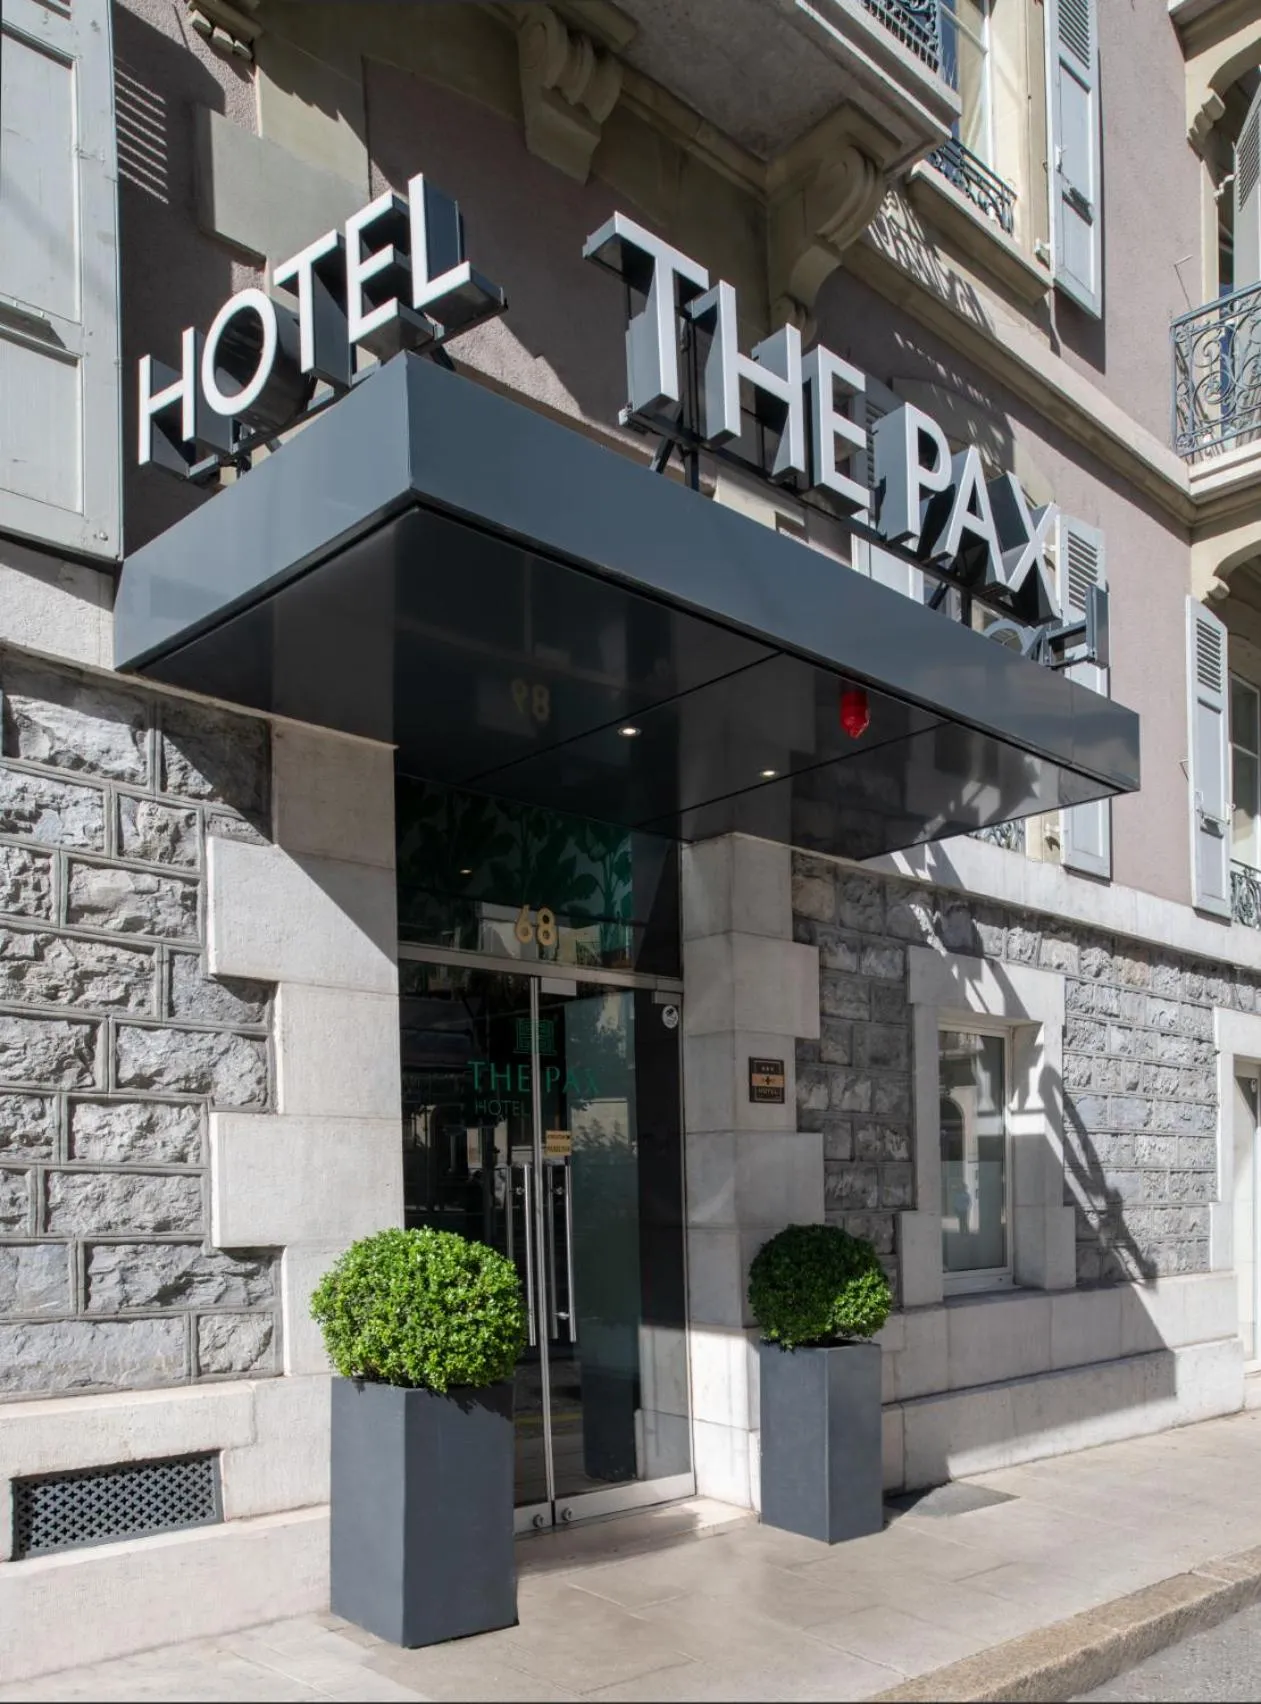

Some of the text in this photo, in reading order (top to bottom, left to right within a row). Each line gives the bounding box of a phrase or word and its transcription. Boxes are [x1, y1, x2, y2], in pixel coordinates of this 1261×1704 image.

[138, 173, 472, 466] HOTEL
[611, 211, 1063, 622] THE PAX
[514, 904, 557, 945] 68
[467, 1060, 532, 1092] THE
[475, 1099, 531, 1118] HOTEL
